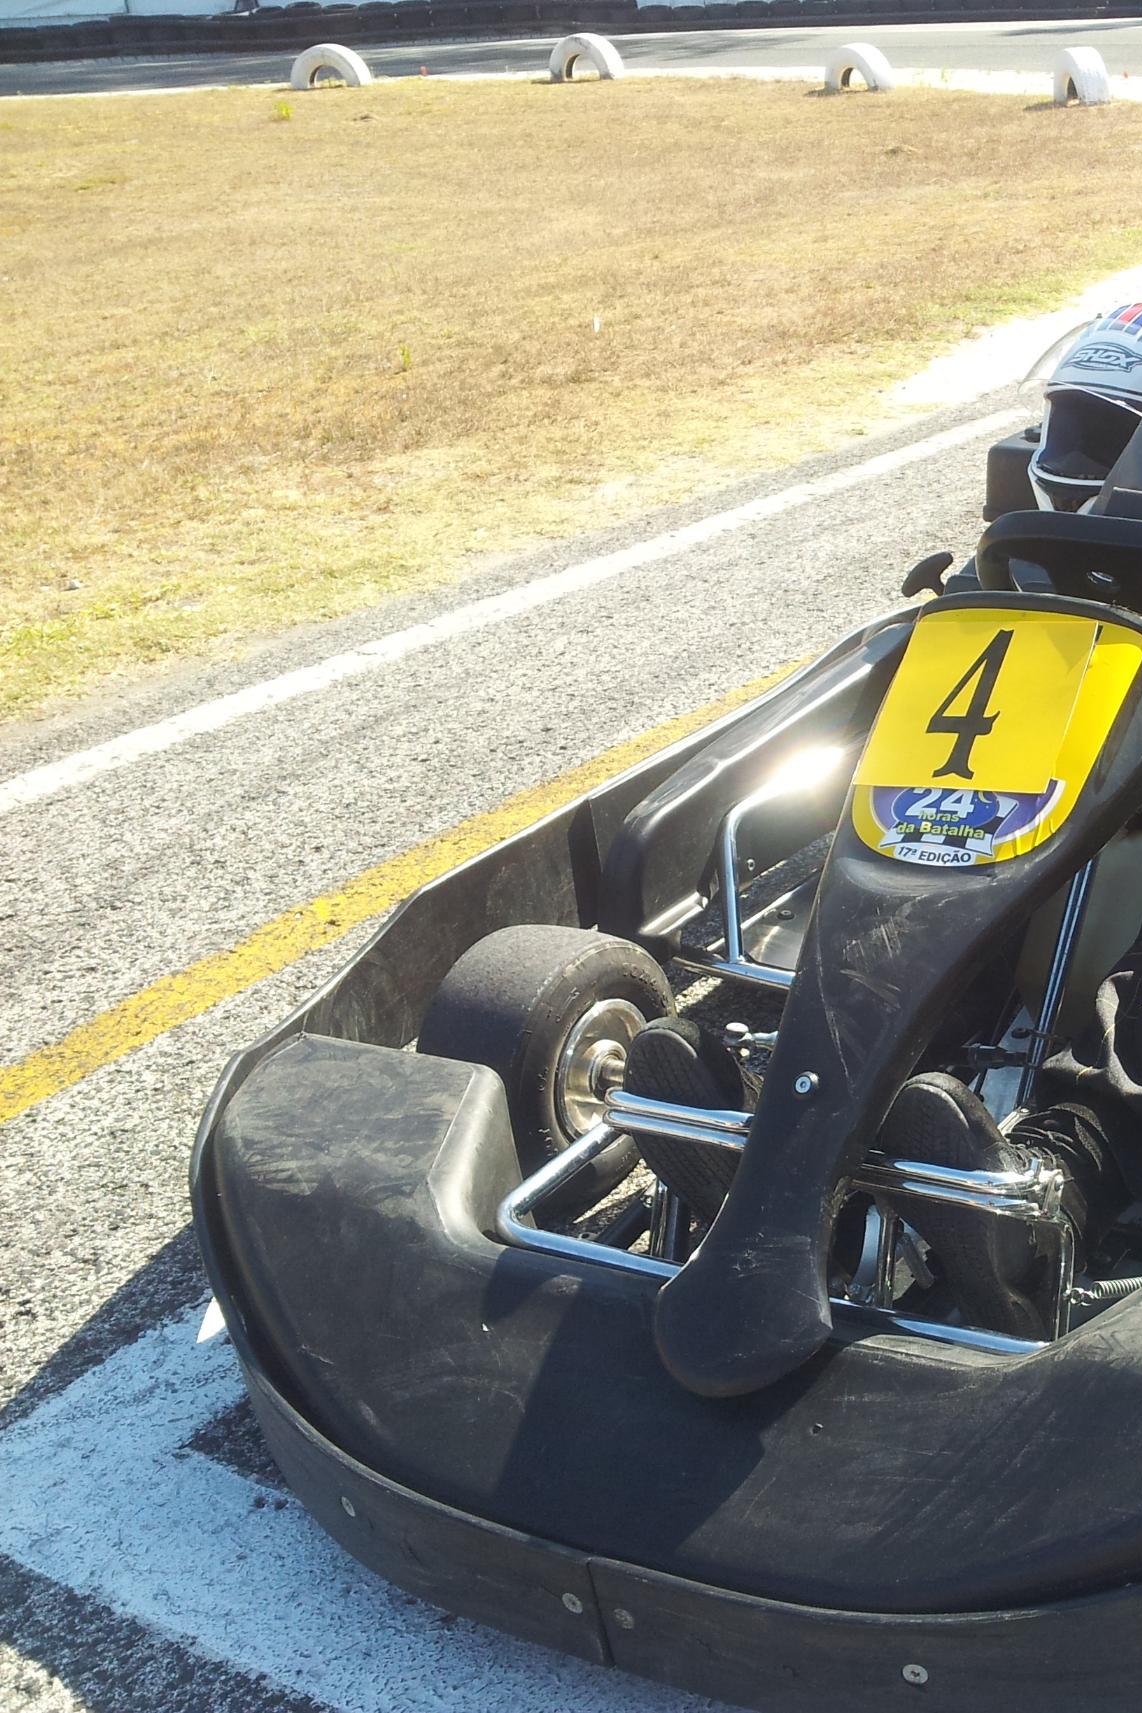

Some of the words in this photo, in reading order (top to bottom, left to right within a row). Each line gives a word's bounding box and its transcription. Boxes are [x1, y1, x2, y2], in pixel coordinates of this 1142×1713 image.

[925, 628, 1016, 780] 4
[905, 787, 975, 819] 24
[896, 822, 915, 834] da
[919, 821, 985, 839] Batalha
[918, 850, 972, 864] EDIÇÃO
